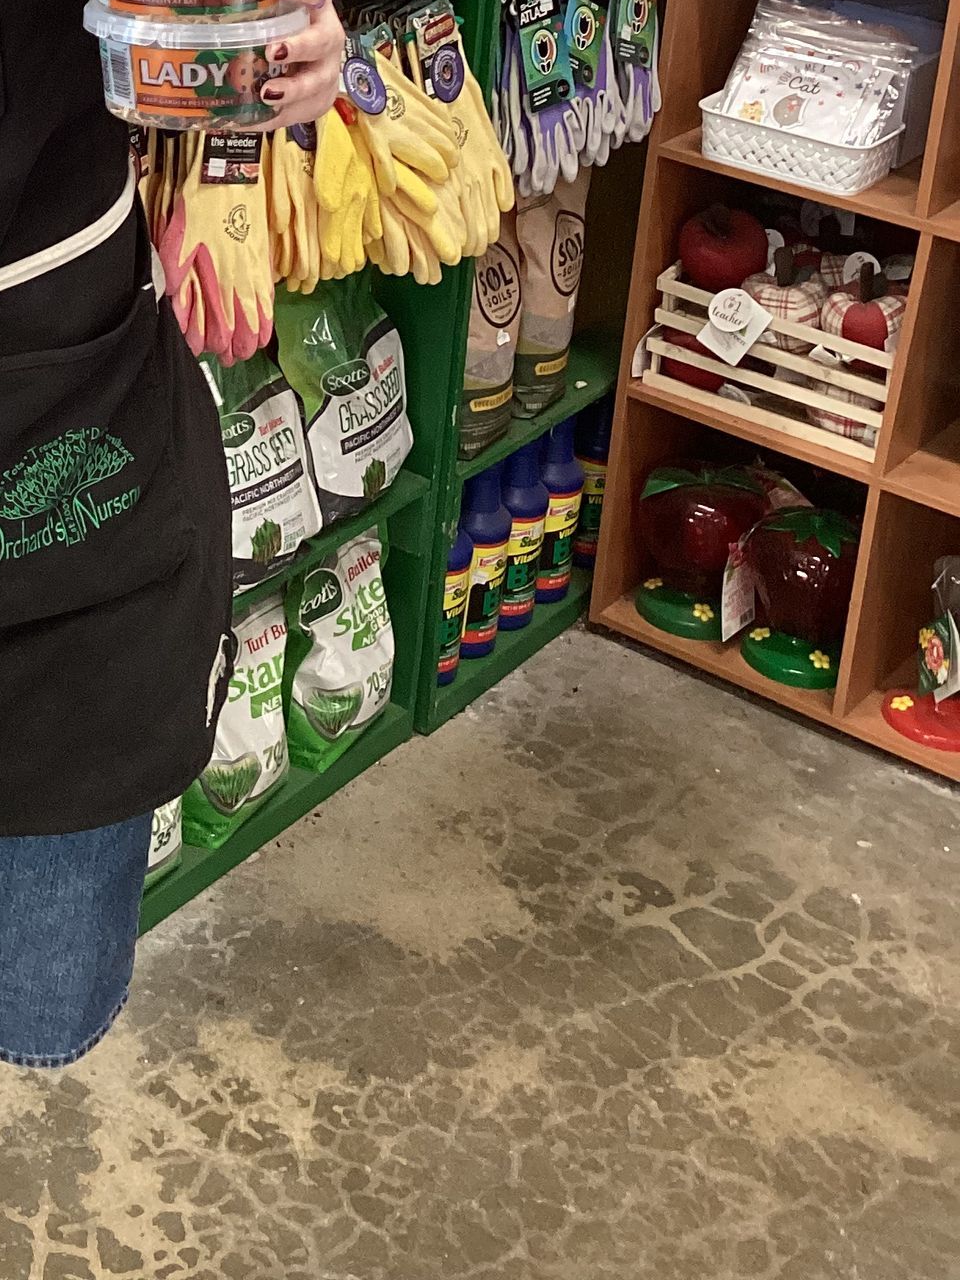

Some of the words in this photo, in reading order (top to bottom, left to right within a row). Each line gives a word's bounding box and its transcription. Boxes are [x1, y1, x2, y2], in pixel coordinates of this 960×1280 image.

[139, 58, 230, 89] LADY
[788, 76, 821, 95] Cat
[210, 136, 225, 147] the
[226, 136, 257, 147] weeder
[479, 261, 513, 297] SOL
[487, 288, 513, 309] SOILS
[712, 304, 744, 327] teacher
[327, 364, 369, 392] Scotts
[380, 366, 401, 408] SEED
[344, 429, 371, 452] PACIFIC
[227, 441, 272, 488] GRASS
[270, 426, 299, 468] SEED
[231, 487, 260, 506] PACIFIC
[260, 468, 296, 495] NORTHWEST
[347, 551, 380, 582] Builde
[243, 631, 270, 655] Turf
[228, 652, 285, 704] Star
[260, 694, 283, 714] NE
